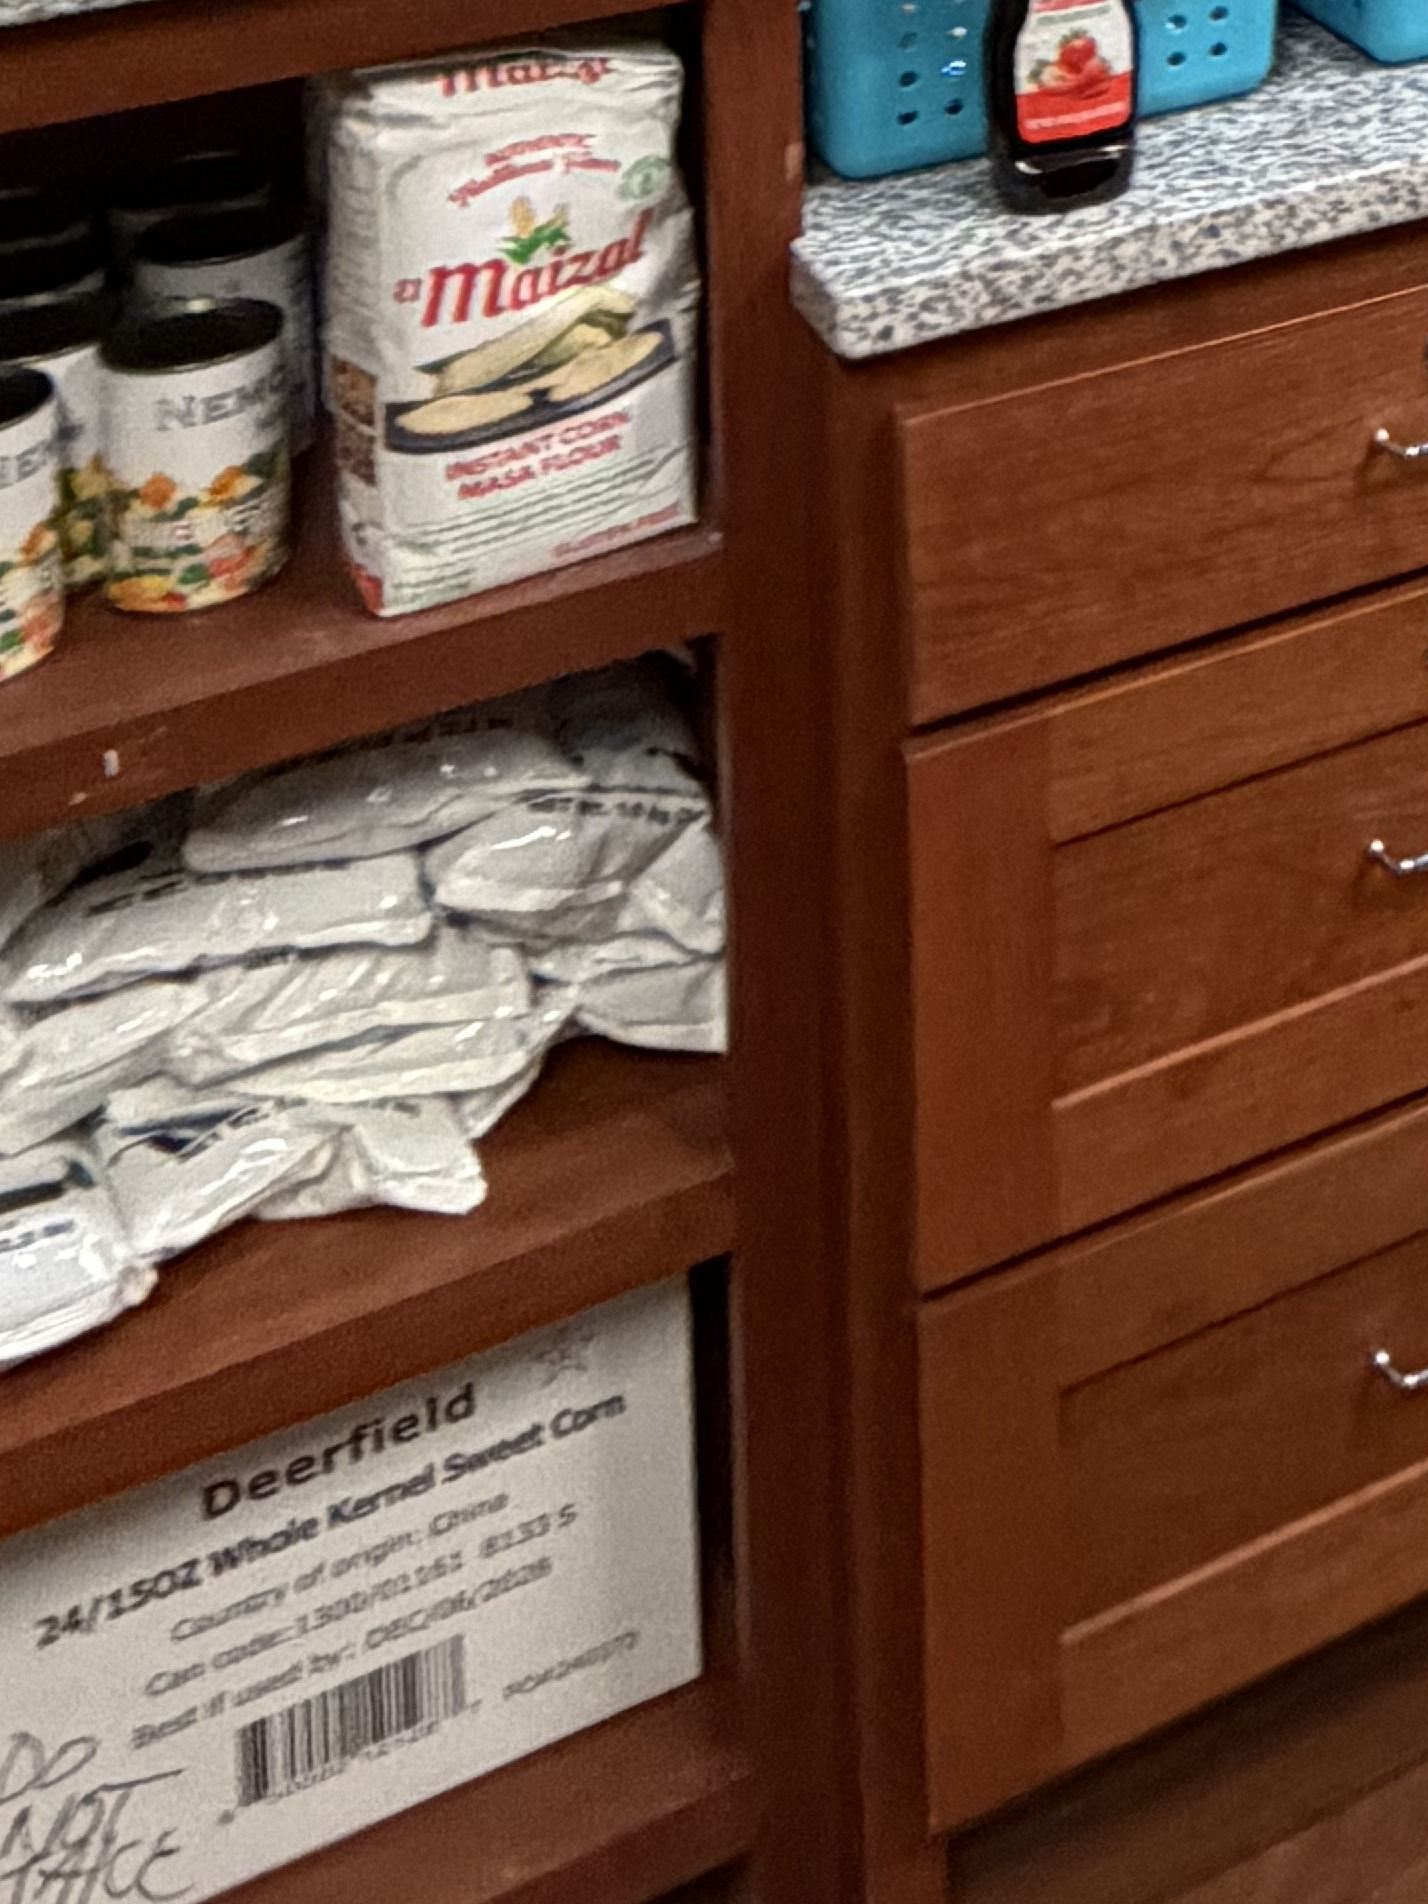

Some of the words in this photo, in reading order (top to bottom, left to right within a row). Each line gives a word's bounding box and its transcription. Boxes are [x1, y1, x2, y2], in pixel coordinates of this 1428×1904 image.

[445, 433, 554, 482] INSTANT
[557, 411, 630, 445] CORN
[457, 465, 536, 501] MASA
[541, 433, 621, 475] FLOUR
[202, 1382, 476, 1521] Deerfield
[208, 1516, 320, 1578] Whole
[326, 1462, 436, 1530] Kernel
[441, 1422, 546, 1485] Sweet
[549, 1394, 627, 1440] Corn
[170, 1582, 290, 1642] Country
[294, 1561, 326, 1594] of
[428, 1492, 509, 1538] China
[131, 1705, 199, 1751] Best
[232, 1659, 304, 1708] used
[145, 1662, 206, 1696] Can
